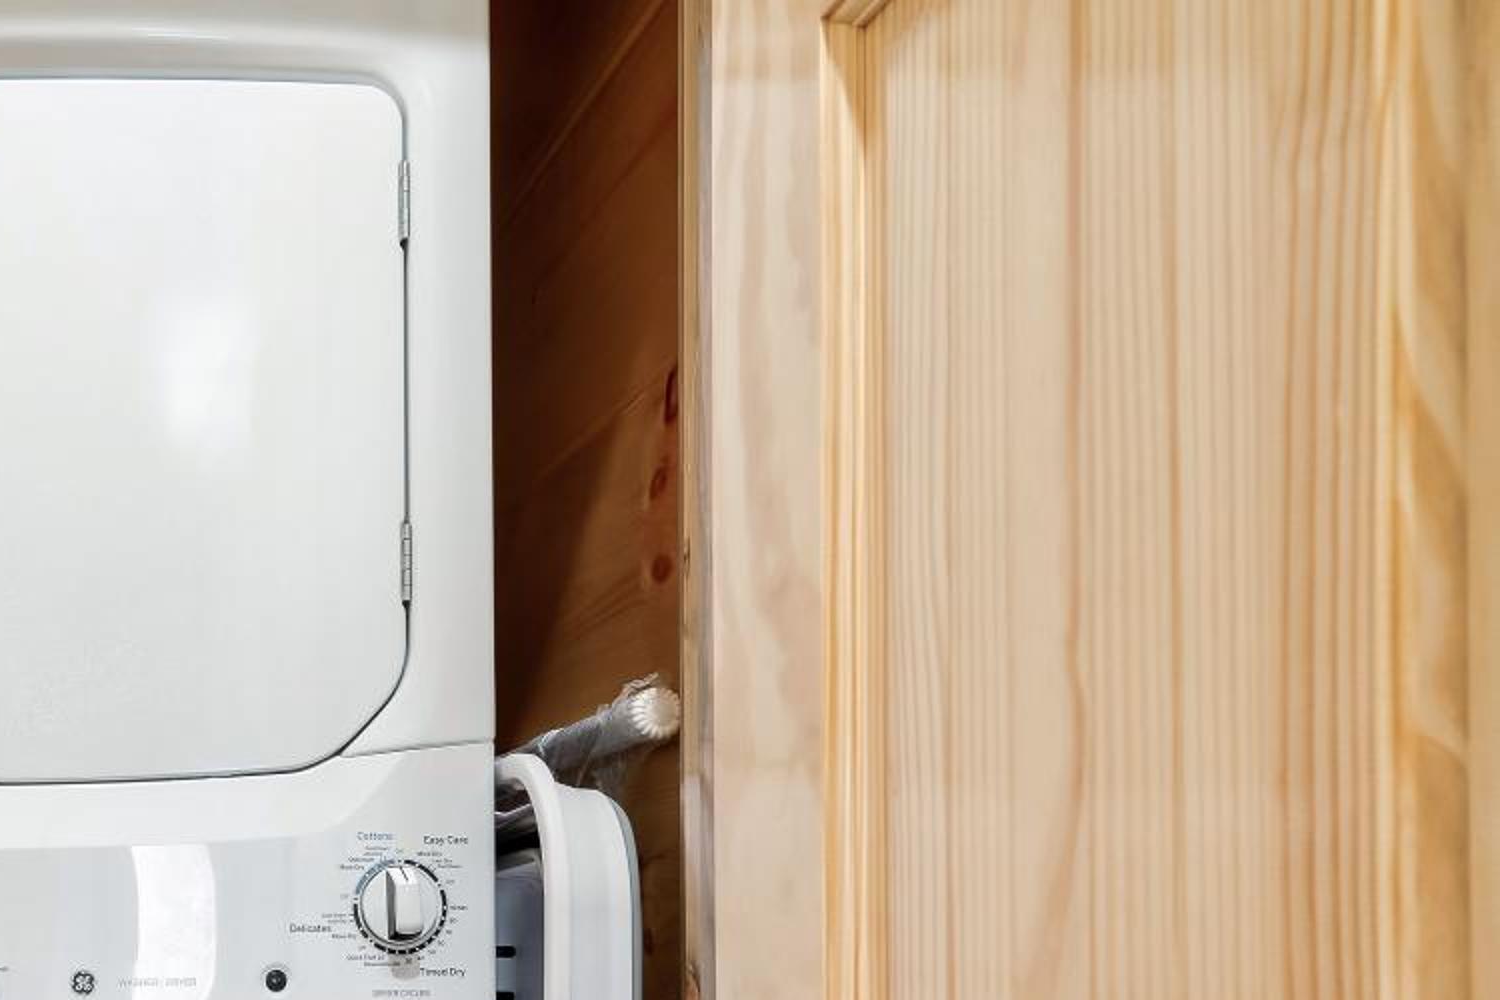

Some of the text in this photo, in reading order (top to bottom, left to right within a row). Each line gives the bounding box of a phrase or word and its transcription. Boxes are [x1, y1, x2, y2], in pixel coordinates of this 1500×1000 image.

[423, 835, 468, 846] Easy Care
[289, 923, 332, 933] Delicates
[420, 967, 467, 979] Timed Dry
